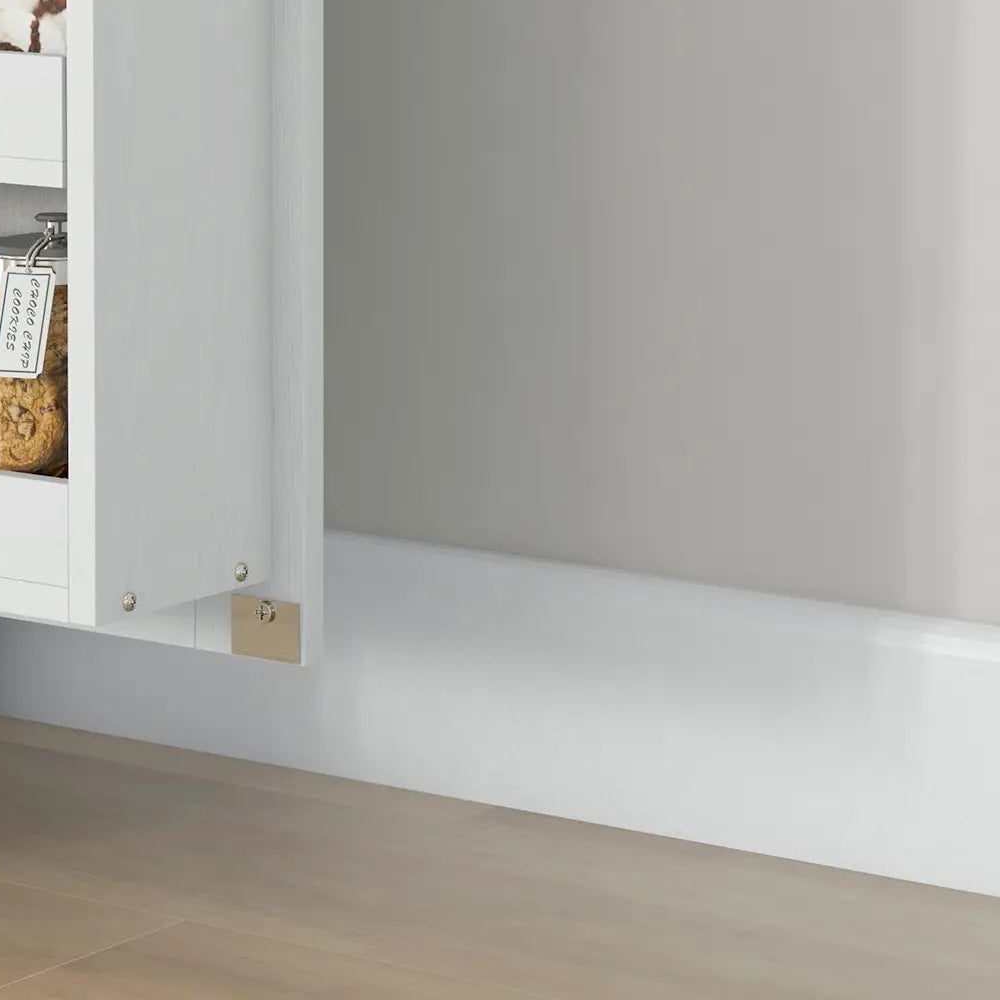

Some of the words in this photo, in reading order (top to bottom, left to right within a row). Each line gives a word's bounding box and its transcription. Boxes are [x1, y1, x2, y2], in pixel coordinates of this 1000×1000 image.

[6, 288, 22, 352] COOKIES
[25, 277, 40, 326] CHOCO
[19, 330, 33, 369] CHIP
